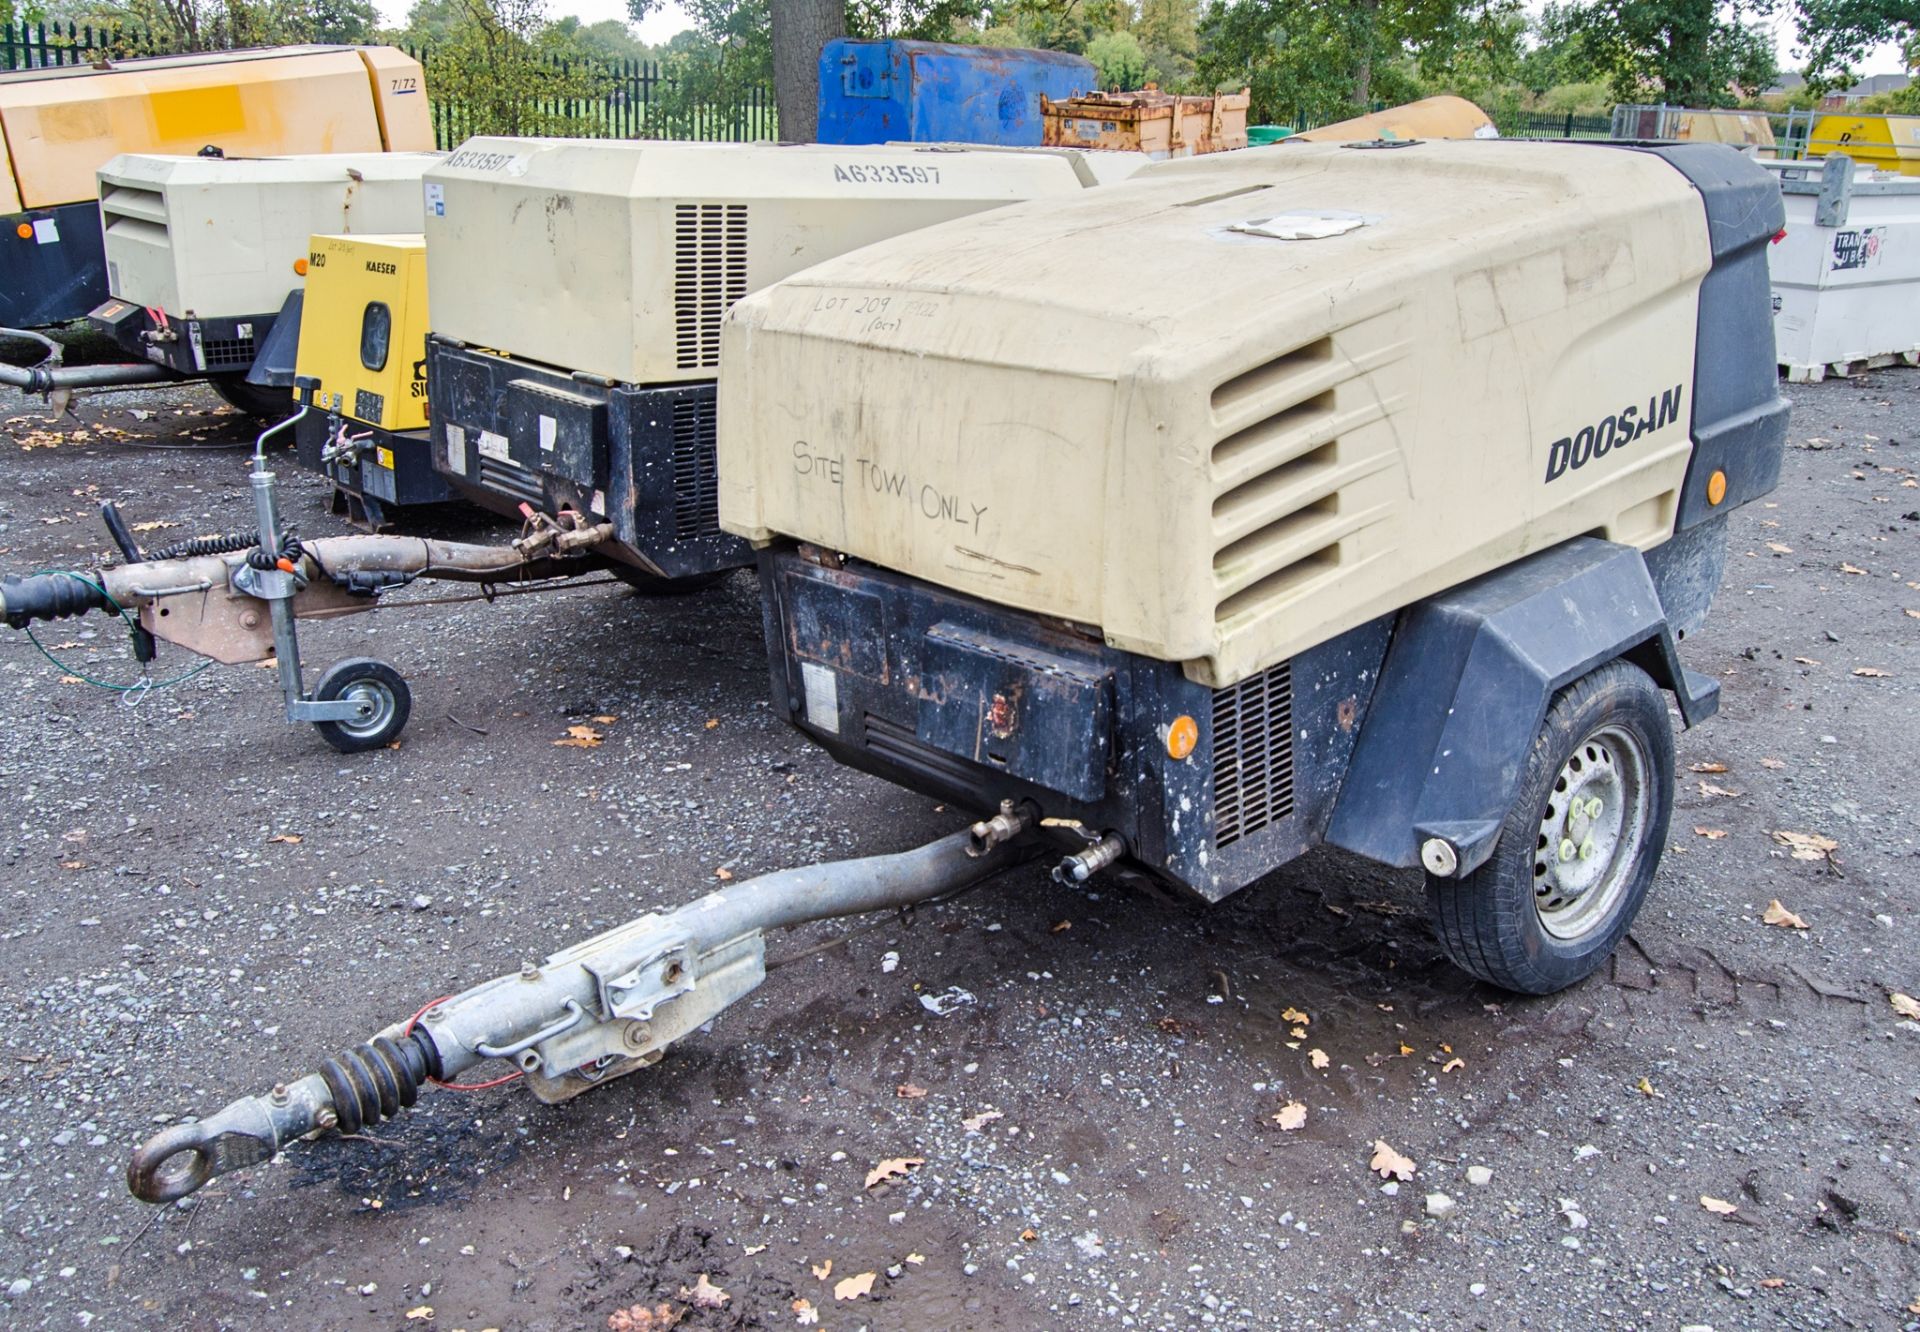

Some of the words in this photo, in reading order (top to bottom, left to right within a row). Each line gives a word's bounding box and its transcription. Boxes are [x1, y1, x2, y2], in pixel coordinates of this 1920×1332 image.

[391, 78, 416, 90] 7/72
[442, 150, 515, 171] A633597
[834, 163, 939, 184] A633597
[310, 252, 326, 267] M20
[366, 260, 396, 274] KAESER
[814, 295, 848, 311] LOT
[855, 296, 891, 314] 209
[1544, 384, 1683, 485] DOOSAN
[856, 458, 906, 497] TOW
[921, 484, 988, 535] ONLY
